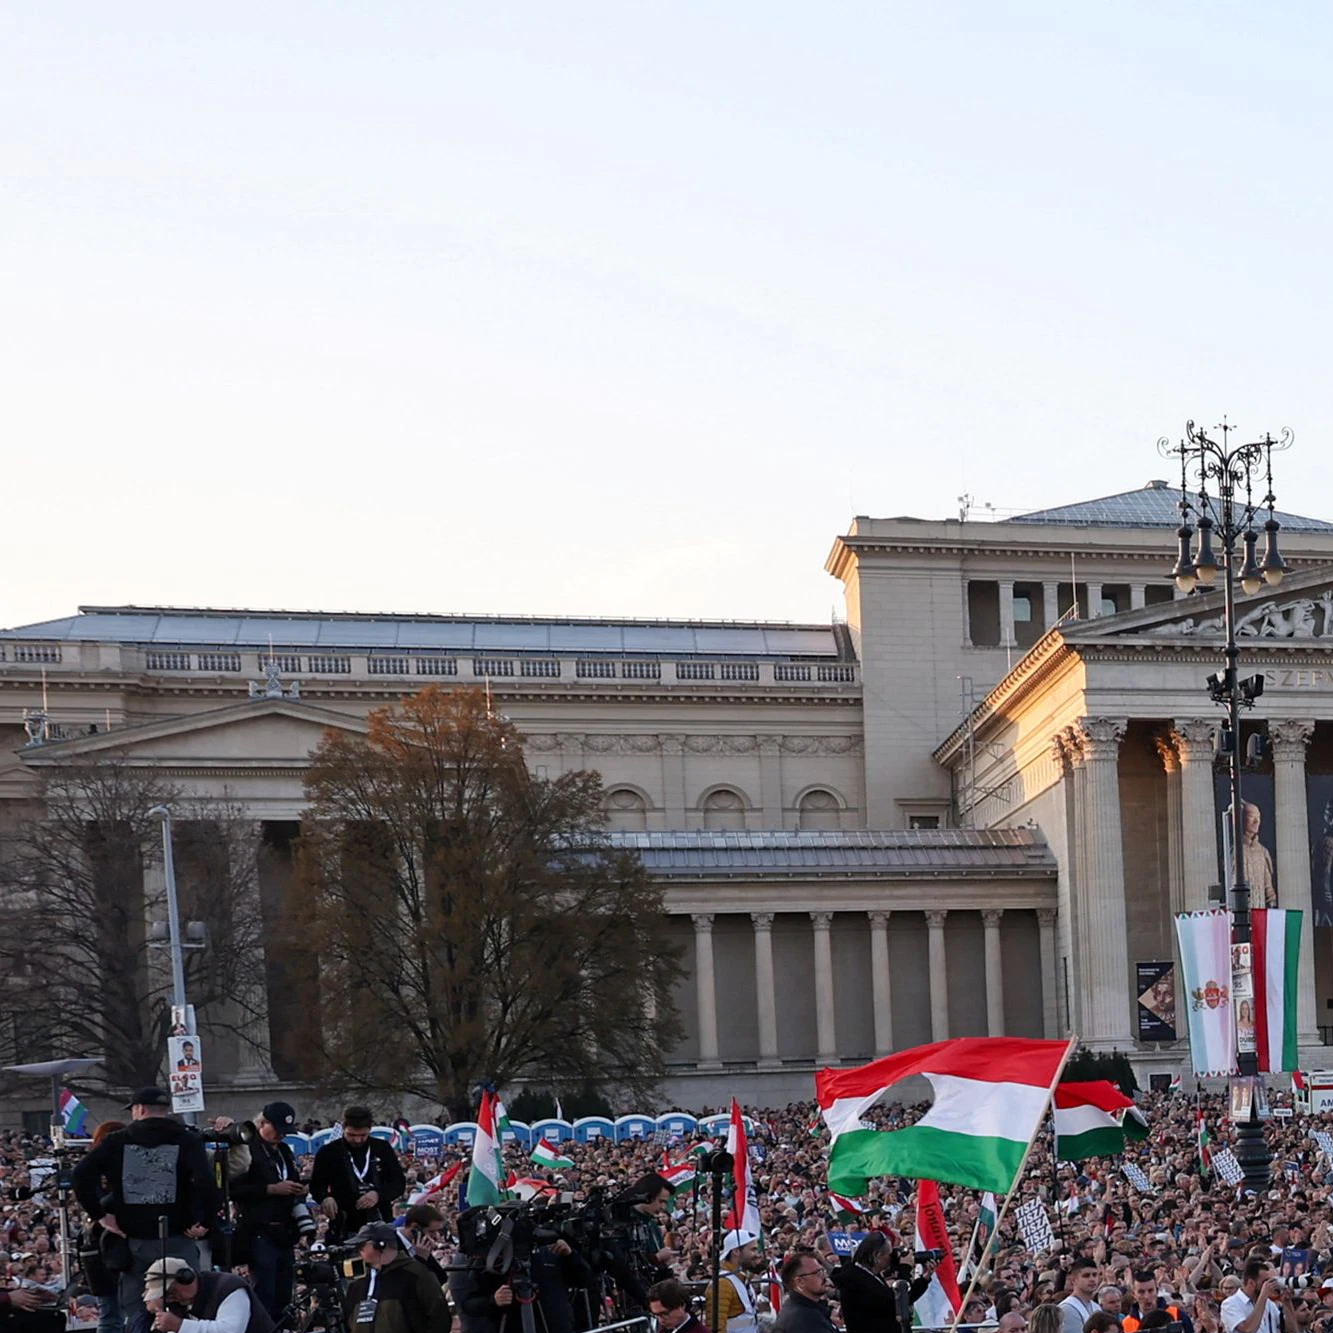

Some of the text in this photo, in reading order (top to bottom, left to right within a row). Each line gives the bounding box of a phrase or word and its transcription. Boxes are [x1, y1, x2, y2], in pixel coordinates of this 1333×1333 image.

[1014, 1196, 1042, 1219] TISZA
[1018, 1205, 1046, 1229] TISZA
[1022, 1214, 1050, 1239] TISZA
[1024, 1223, 1054, 1249] TISZA
